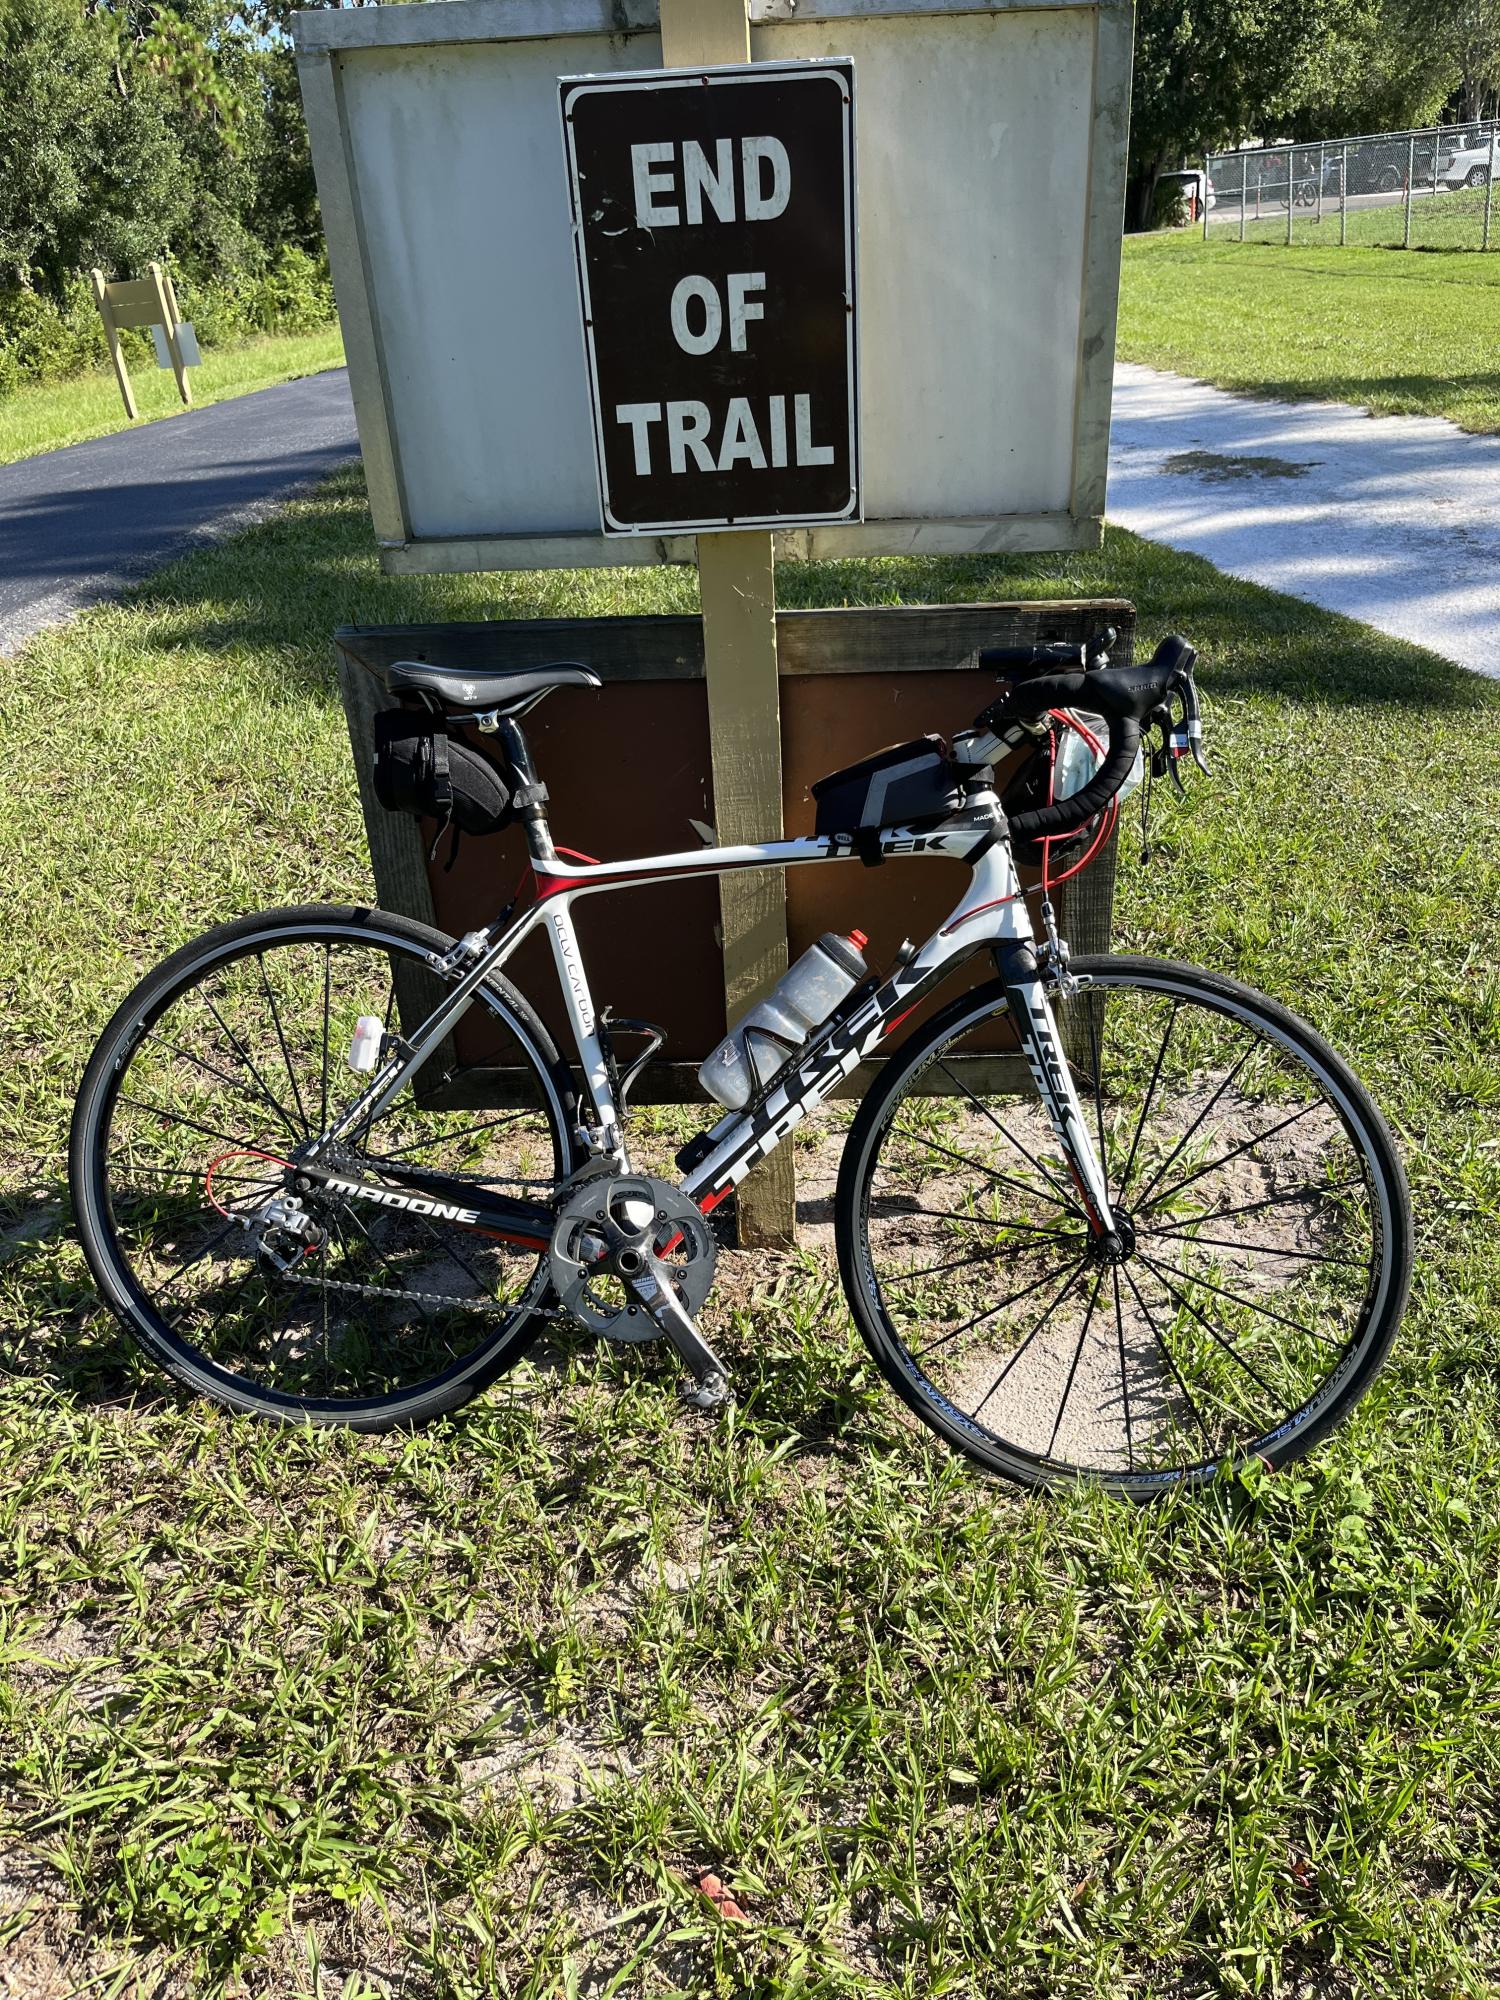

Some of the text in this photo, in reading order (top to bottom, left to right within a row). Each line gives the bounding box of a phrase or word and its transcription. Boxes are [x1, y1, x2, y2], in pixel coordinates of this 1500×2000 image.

[630, 135, 792, 229] END
[669, 272, 767, 356] OF
[616, 393, 835, 476] TRAIL
[817, 836, 949, 857] TEK
[553, 914, 573, 958] OCLV
[714, 1019, 889, 1190] TREK
[325, 1178, 481, 1224] MADONE
